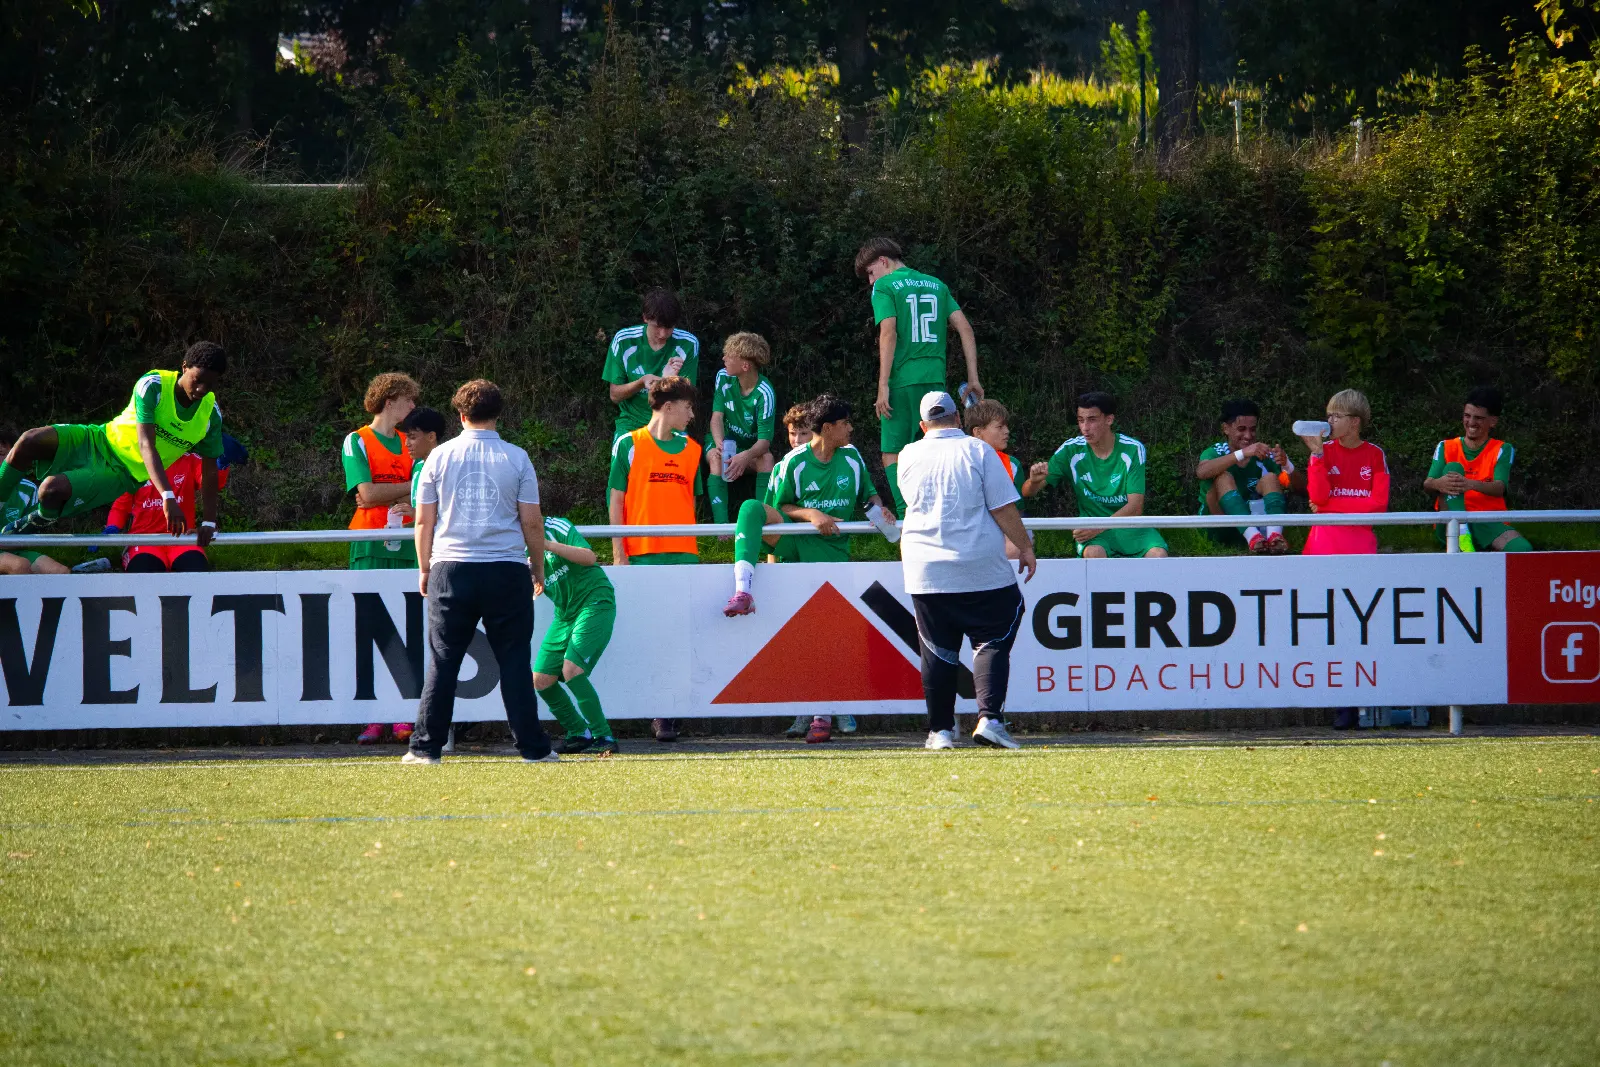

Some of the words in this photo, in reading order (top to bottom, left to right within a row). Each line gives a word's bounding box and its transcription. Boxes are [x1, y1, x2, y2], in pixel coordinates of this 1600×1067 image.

[905, 293, 938, 343] 12
[457, 487, 497, 500] SCHULZ
[803, 498, 850, 509] WÖHRMANN
[1549, 579, 1600, 609] Folg
[1036, 660, 1377, 692] BEDACHUNGEN
